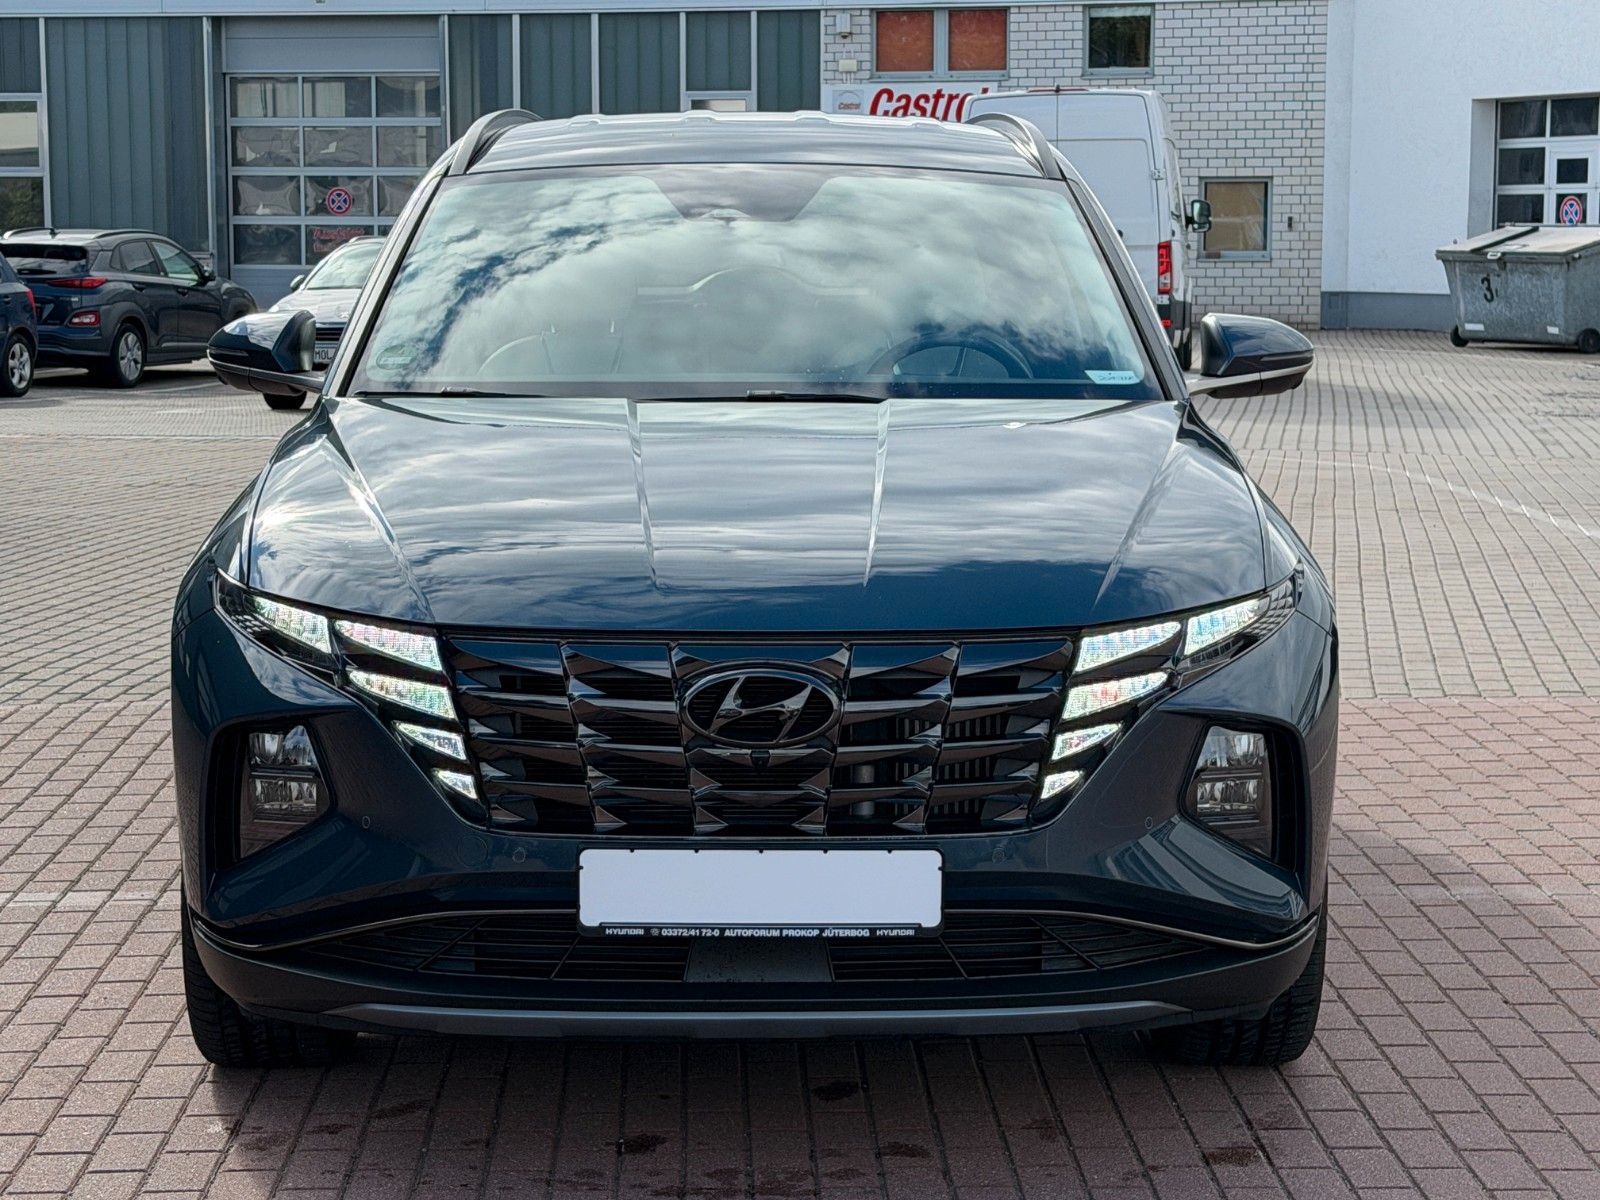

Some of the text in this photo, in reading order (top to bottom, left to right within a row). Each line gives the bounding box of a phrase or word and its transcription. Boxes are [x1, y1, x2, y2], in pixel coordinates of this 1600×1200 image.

[723, 928, 780, 937] AUTOFORUM
[782, 928, 820, 937] PROKOP
[822, 927, 870, 937] JÜTERBOG
